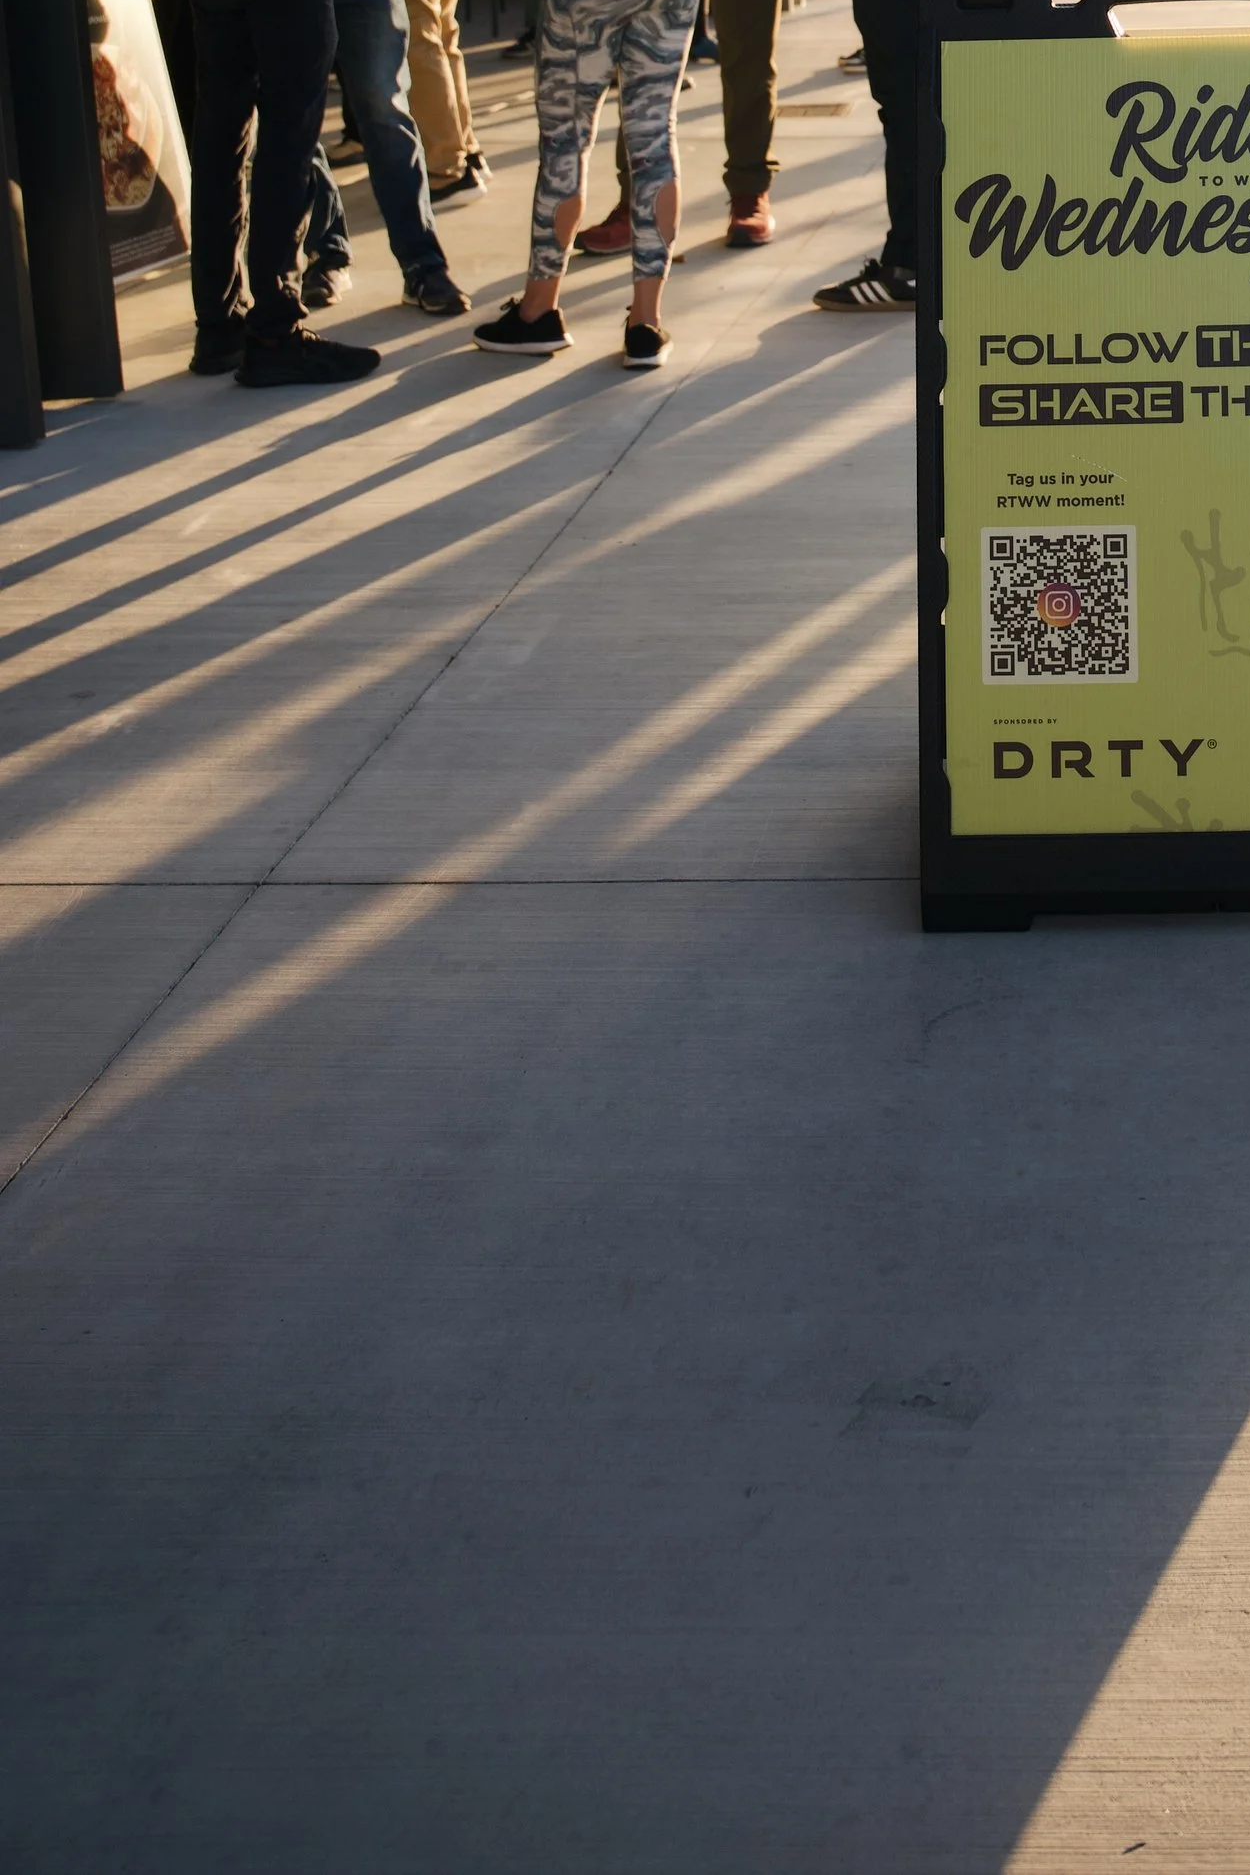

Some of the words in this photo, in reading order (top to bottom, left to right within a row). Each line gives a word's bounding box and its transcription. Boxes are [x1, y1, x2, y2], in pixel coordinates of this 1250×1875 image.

[1199, 175, 1224, 187] TO
[979, 331, 1189, 366] FOLLOW
[991, 387, 1173, 421] SHARE
[1007, 473, 1035, 487] Tag
[1039, 475, 1057, 485] us
[1061, 472, 1075, 485] in
[1079, 473, 1115, 486] your
[997, 495, 1051, 508] RTWW
[1056, 494, 1125, 507] moment!
